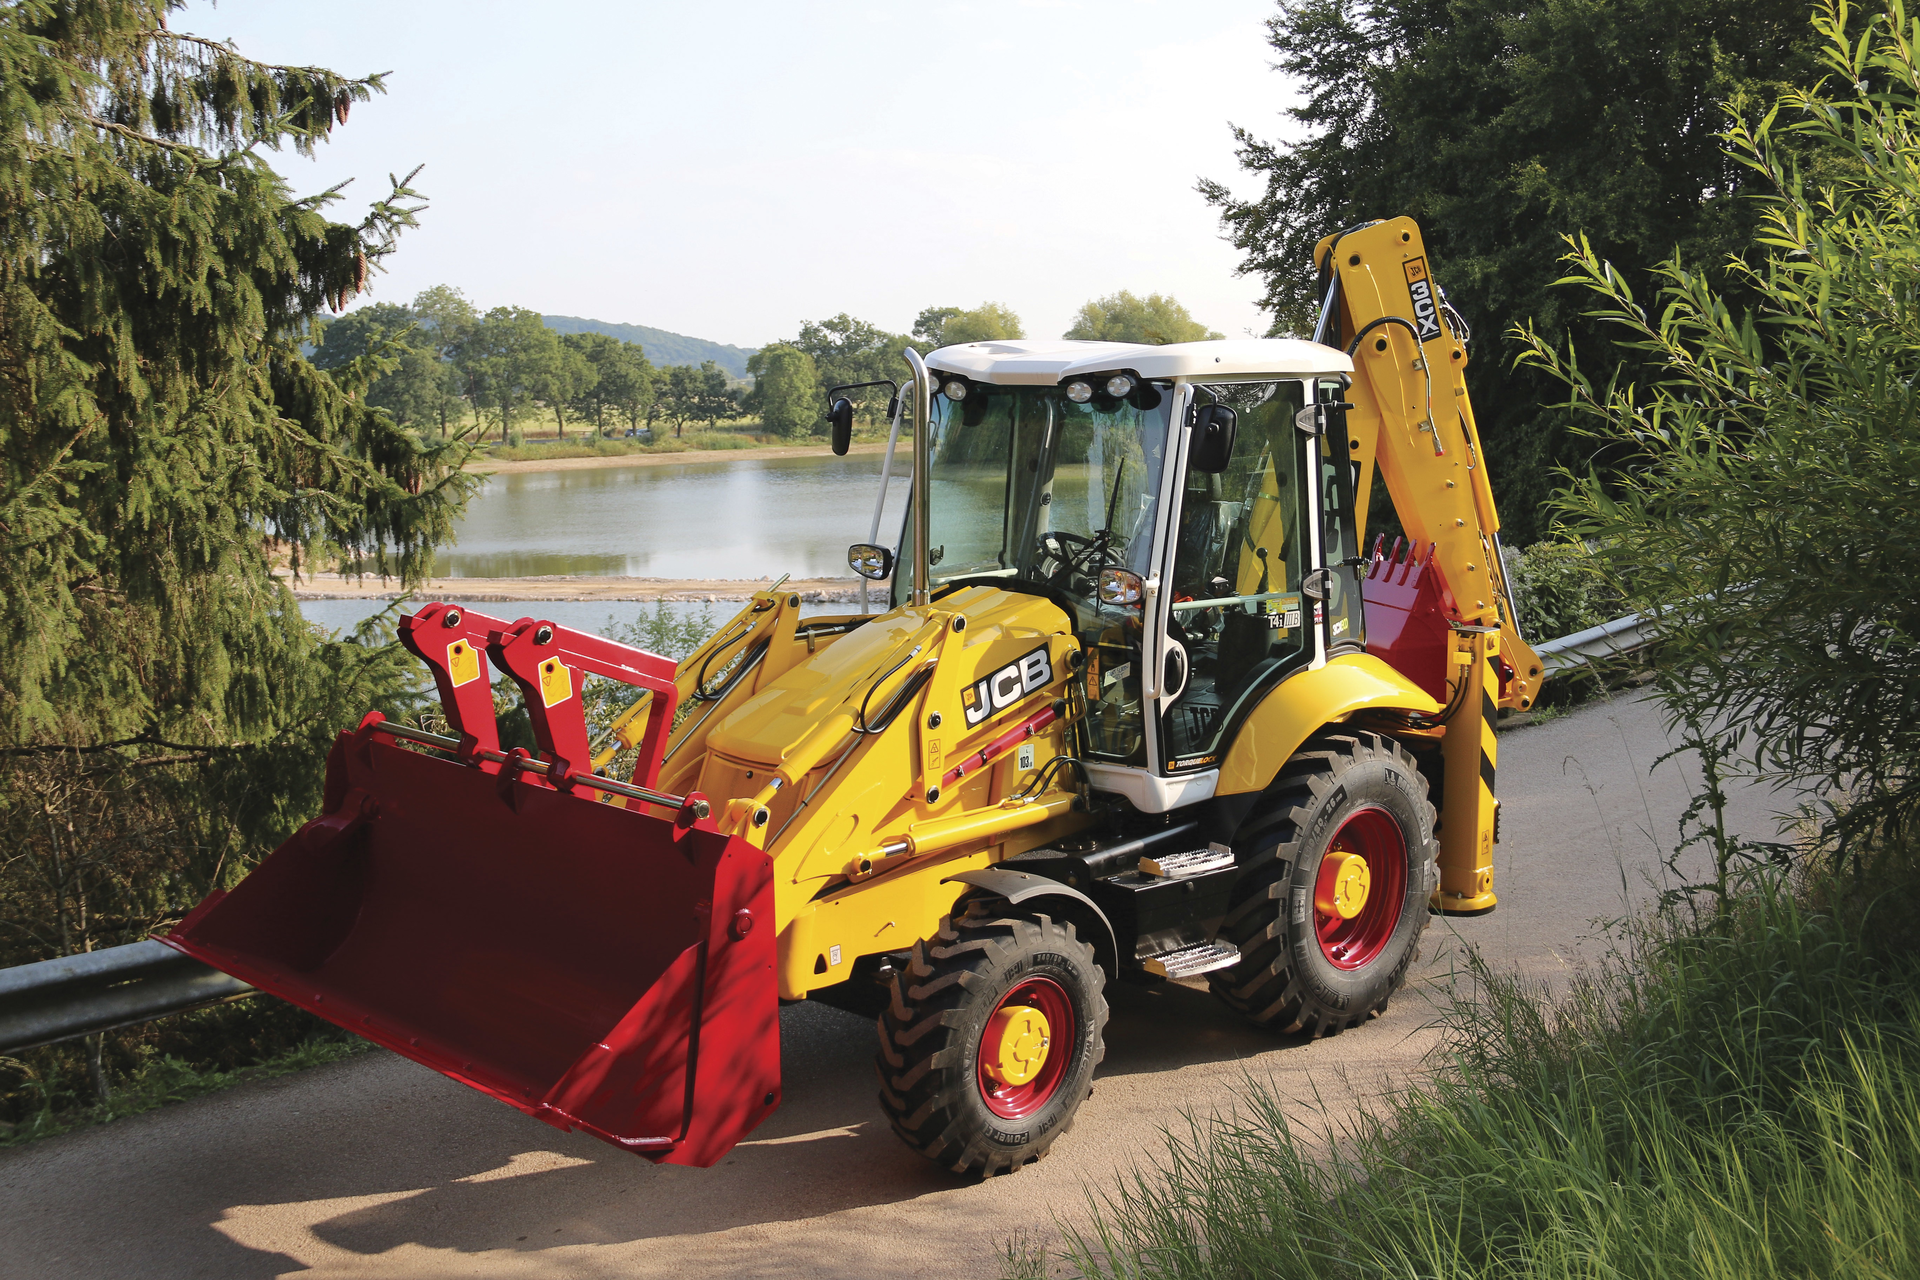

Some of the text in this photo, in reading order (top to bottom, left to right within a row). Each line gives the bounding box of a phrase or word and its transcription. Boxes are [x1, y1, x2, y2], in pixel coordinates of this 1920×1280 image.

[1411, 280, 1440, 336] 3CX
[1268, 614, 1284, 629] T4i
[966, 649, 1051, 724] JCB
[1020, 755, 1030, 769] 103
[1175, 755, 1217, 768] TORQUELOCK
